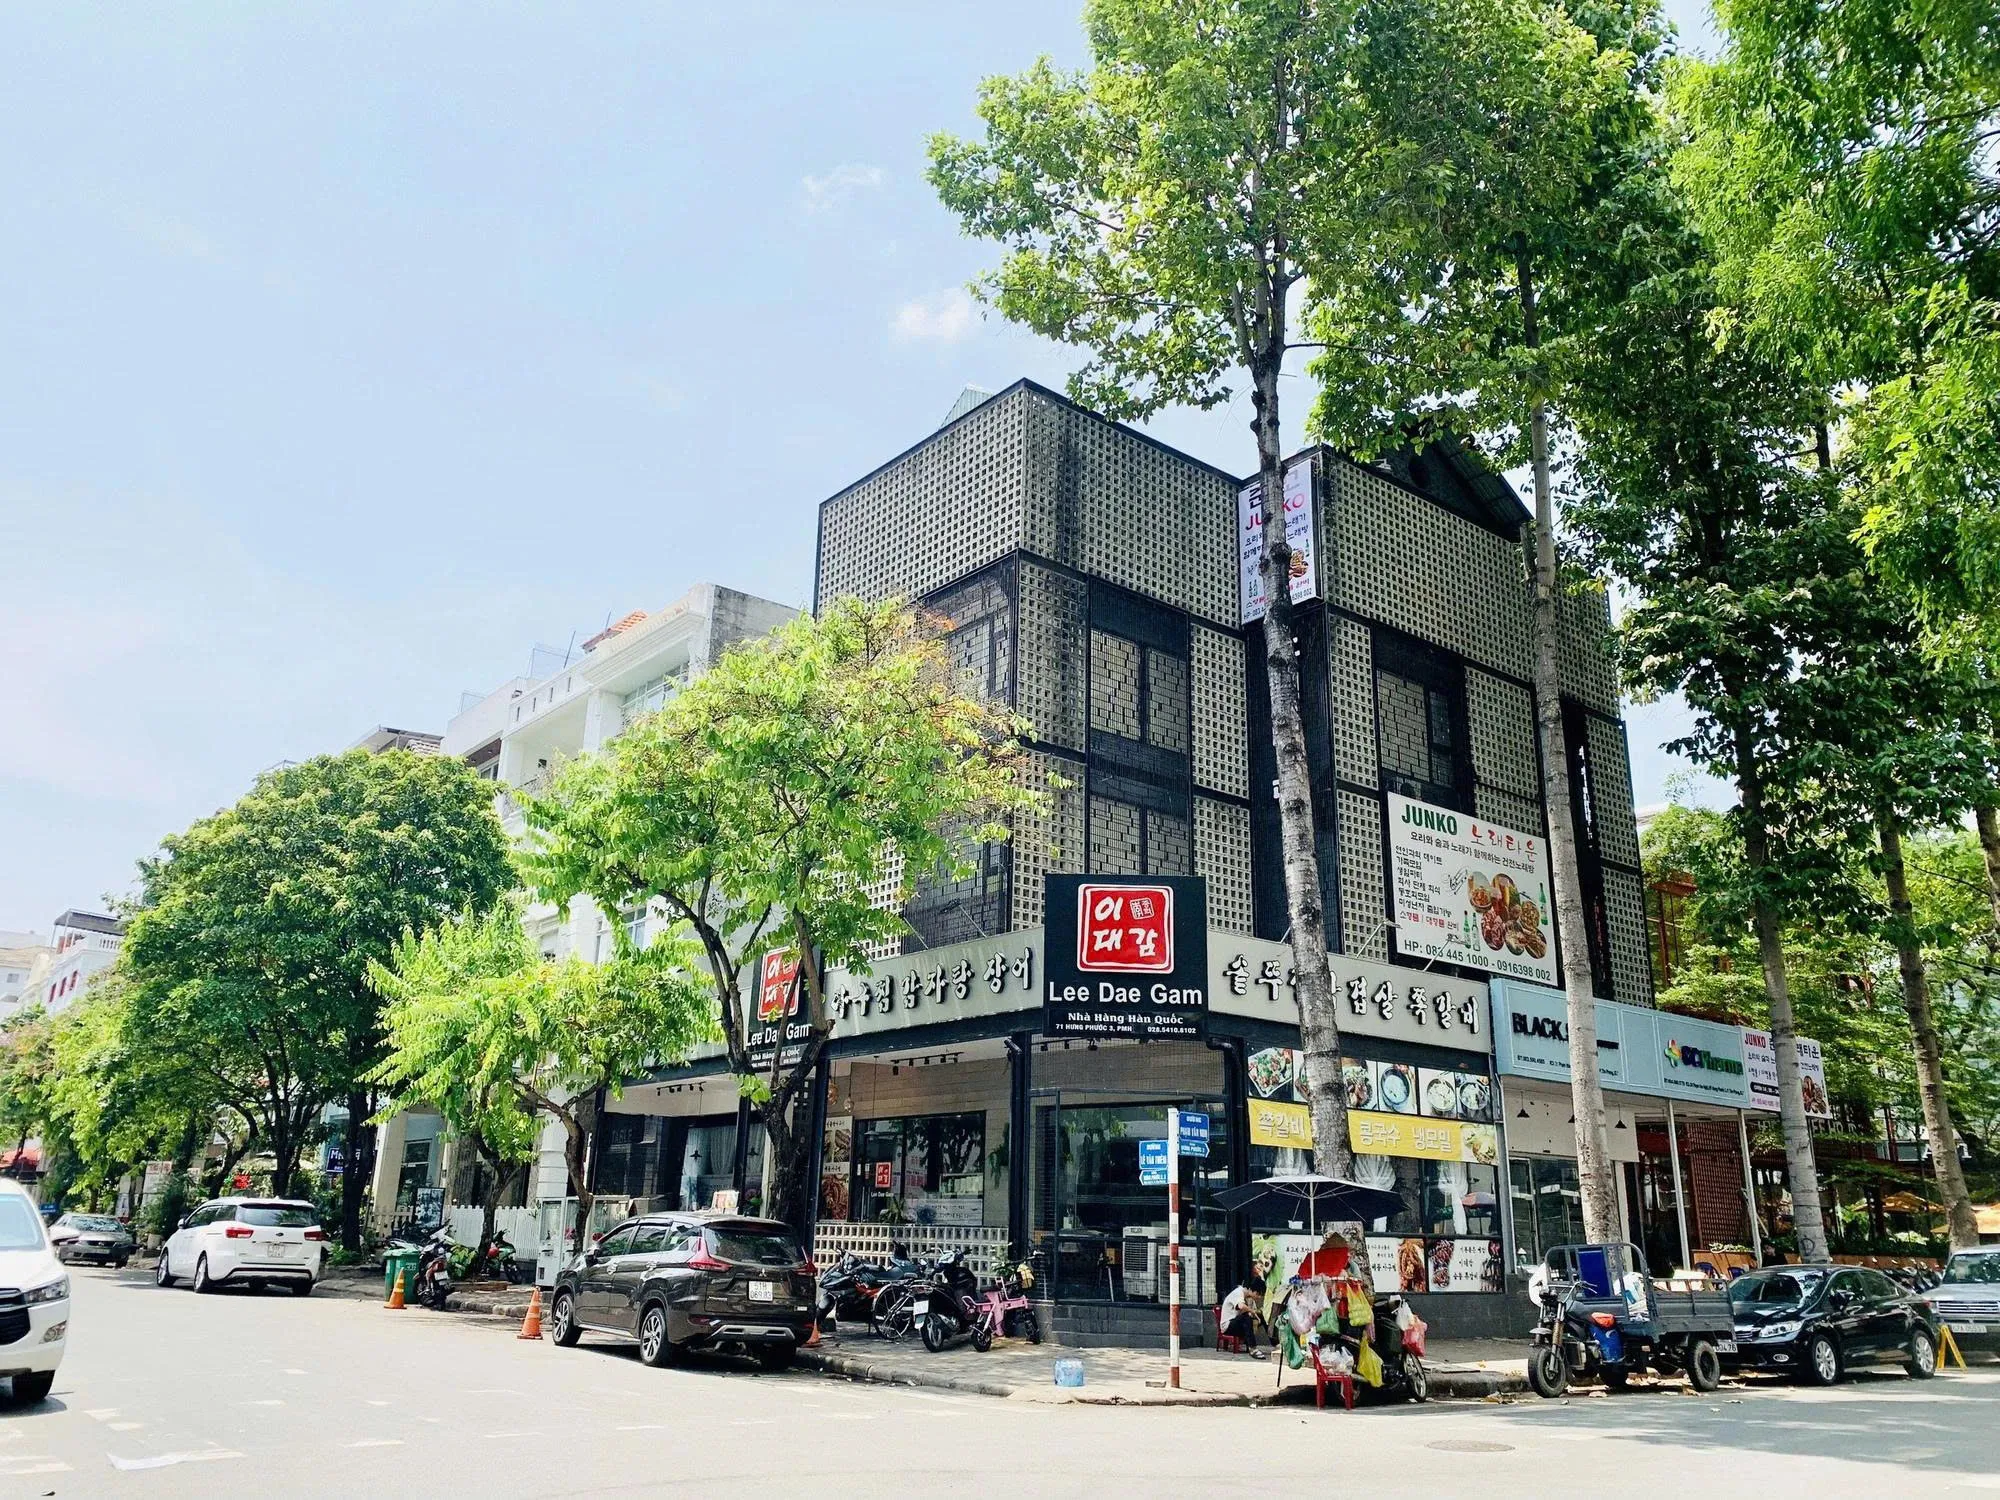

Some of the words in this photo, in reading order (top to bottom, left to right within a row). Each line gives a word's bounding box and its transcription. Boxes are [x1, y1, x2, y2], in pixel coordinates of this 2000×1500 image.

[1245, 494, 1305, 531] JUKO
[1402, 804, 1457, 836] JUNKO
[1471, 824, 1538, 863] 노래타운
[1411, 831, 1433, 845] 요리와
[1435, 838, 1450, 850] 술과
[1451, 842, 1472, 857] 노래가
[1473, 848, 1501, 865] 함께하는
[1446, 949, 1464, 962] 445
[1467, 953, 1489, 968] 1000
[1497, 959, 1534, 976] 0916398
[1535, 971, 1551, 981] 002
[831, 975, 894, 1020] 아구찜
[901, 959, 975, 1010] 감자탕
[983, 946, 1034, 994] 장어
[1049, 981, 1090, 1002] Lee
[1099, 982, 1141, 1004] Dae
[1150, 983, 1203, 1005] Gam
[1223, 954, 1398, 1020] 솥뚜겹살
[1409, 986, 1480, 1034] 쪽갈비
[746, 1031, 763, 1047] Lee
[765, 1027, 779, 1044] Da
[786, 1023, 809, 1040] Gam
[1067, 1012, 1091, 1021] Nhà
[1094, 1013, 1125, 1025] Hàng
[1128, 1014, 1151, 1024] Hàn
[1154, 1013, 1184, 1025] Quốc
[1745, 1033, 1766, 1049] JUNKO
[1258, 1110, 1307, 1141] 쪽갈비
[1360, 1119, 1401, 1147] 콩국수
[1412, 1126, 1453, 1153] 냉모밀
